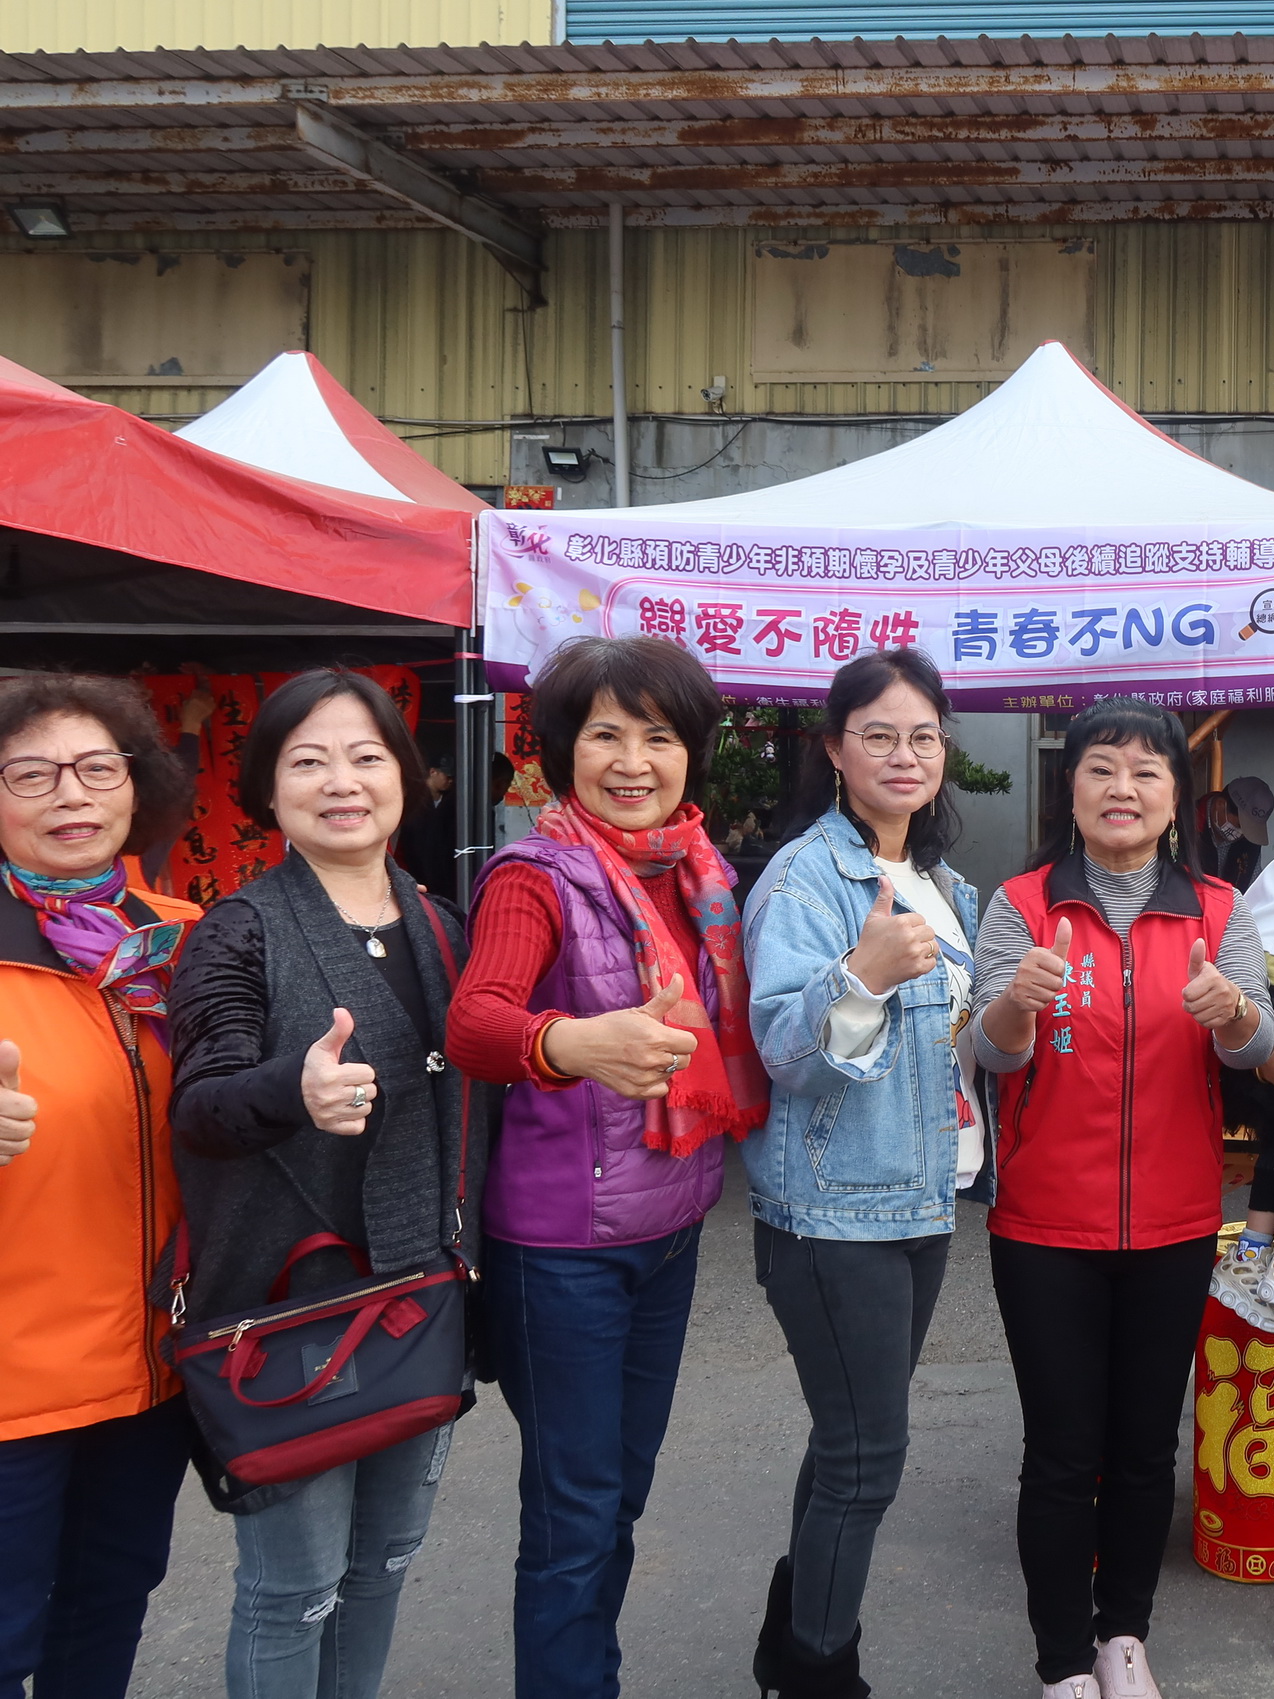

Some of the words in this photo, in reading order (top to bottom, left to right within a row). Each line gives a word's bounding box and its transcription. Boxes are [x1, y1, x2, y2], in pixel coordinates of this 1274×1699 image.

[951, 603, 1218, 661] 青春不NG
[1080, 952, 1096, 1008] 縣議員
